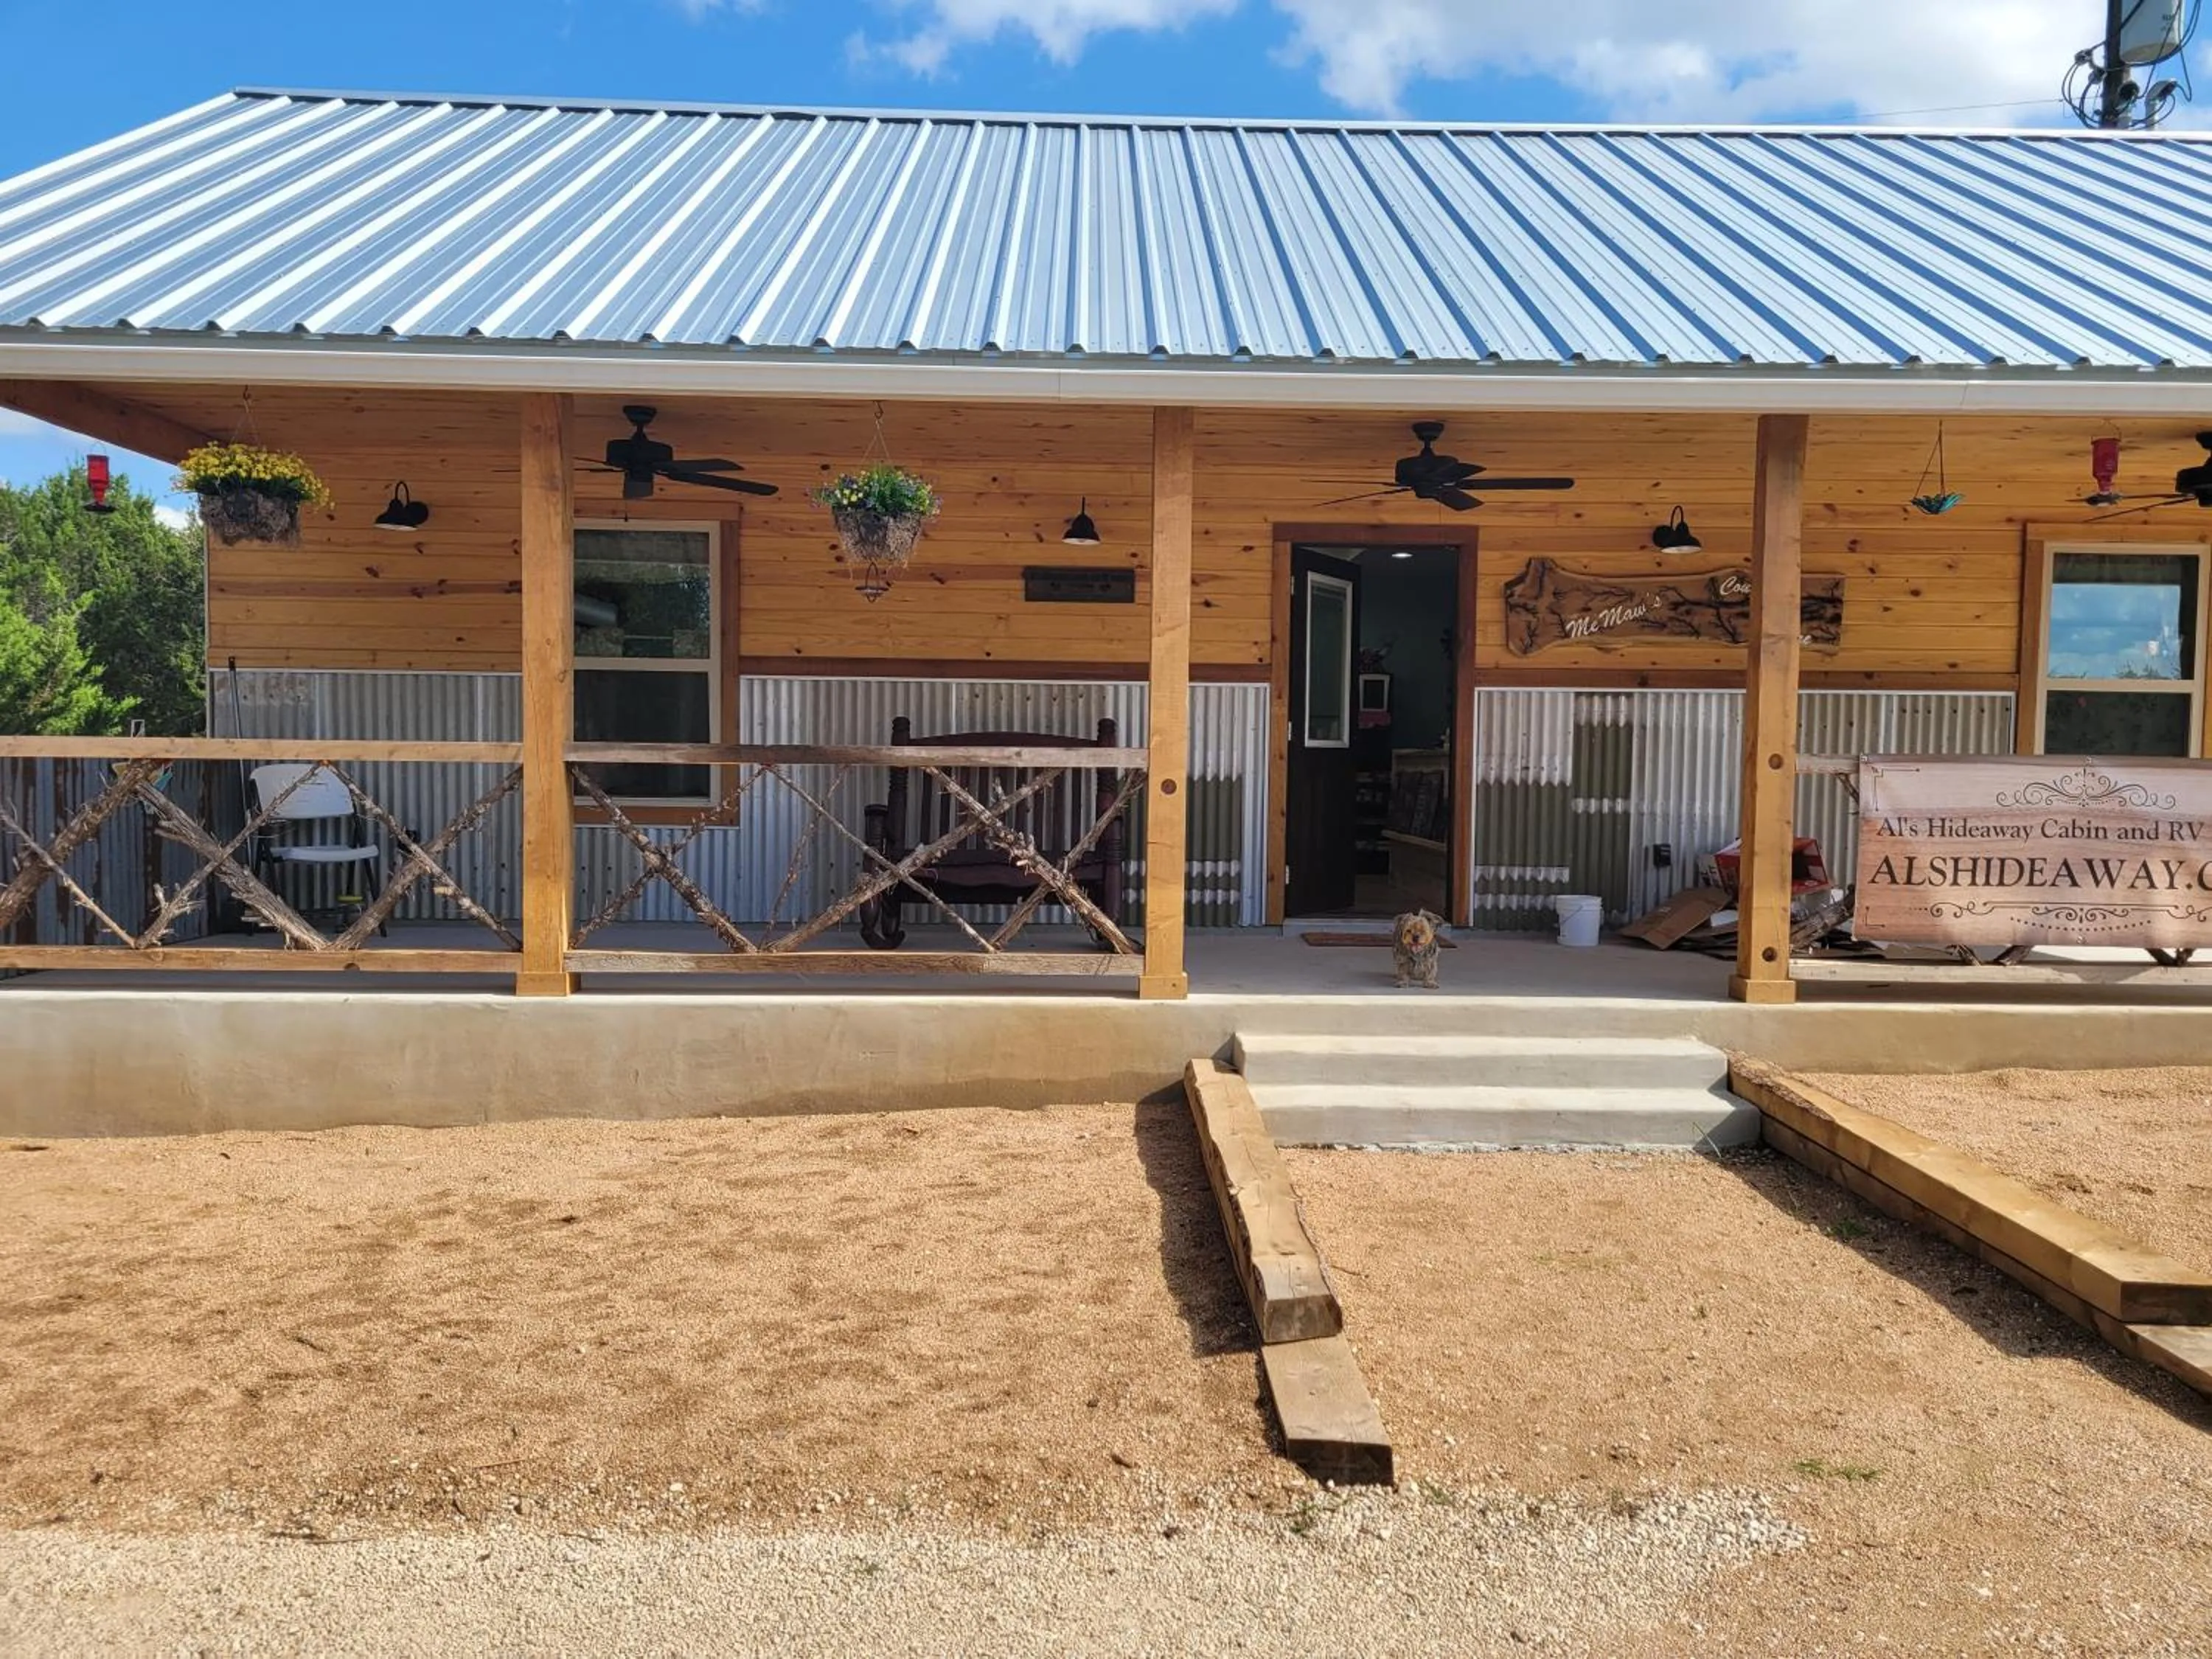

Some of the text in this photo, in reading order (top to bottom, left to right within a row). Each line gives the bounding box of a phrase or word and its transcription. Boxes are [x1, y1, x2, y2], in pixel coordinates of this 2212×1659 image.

[1877, 817, 2205, 845] Al's Hideaway Cabin and RV
